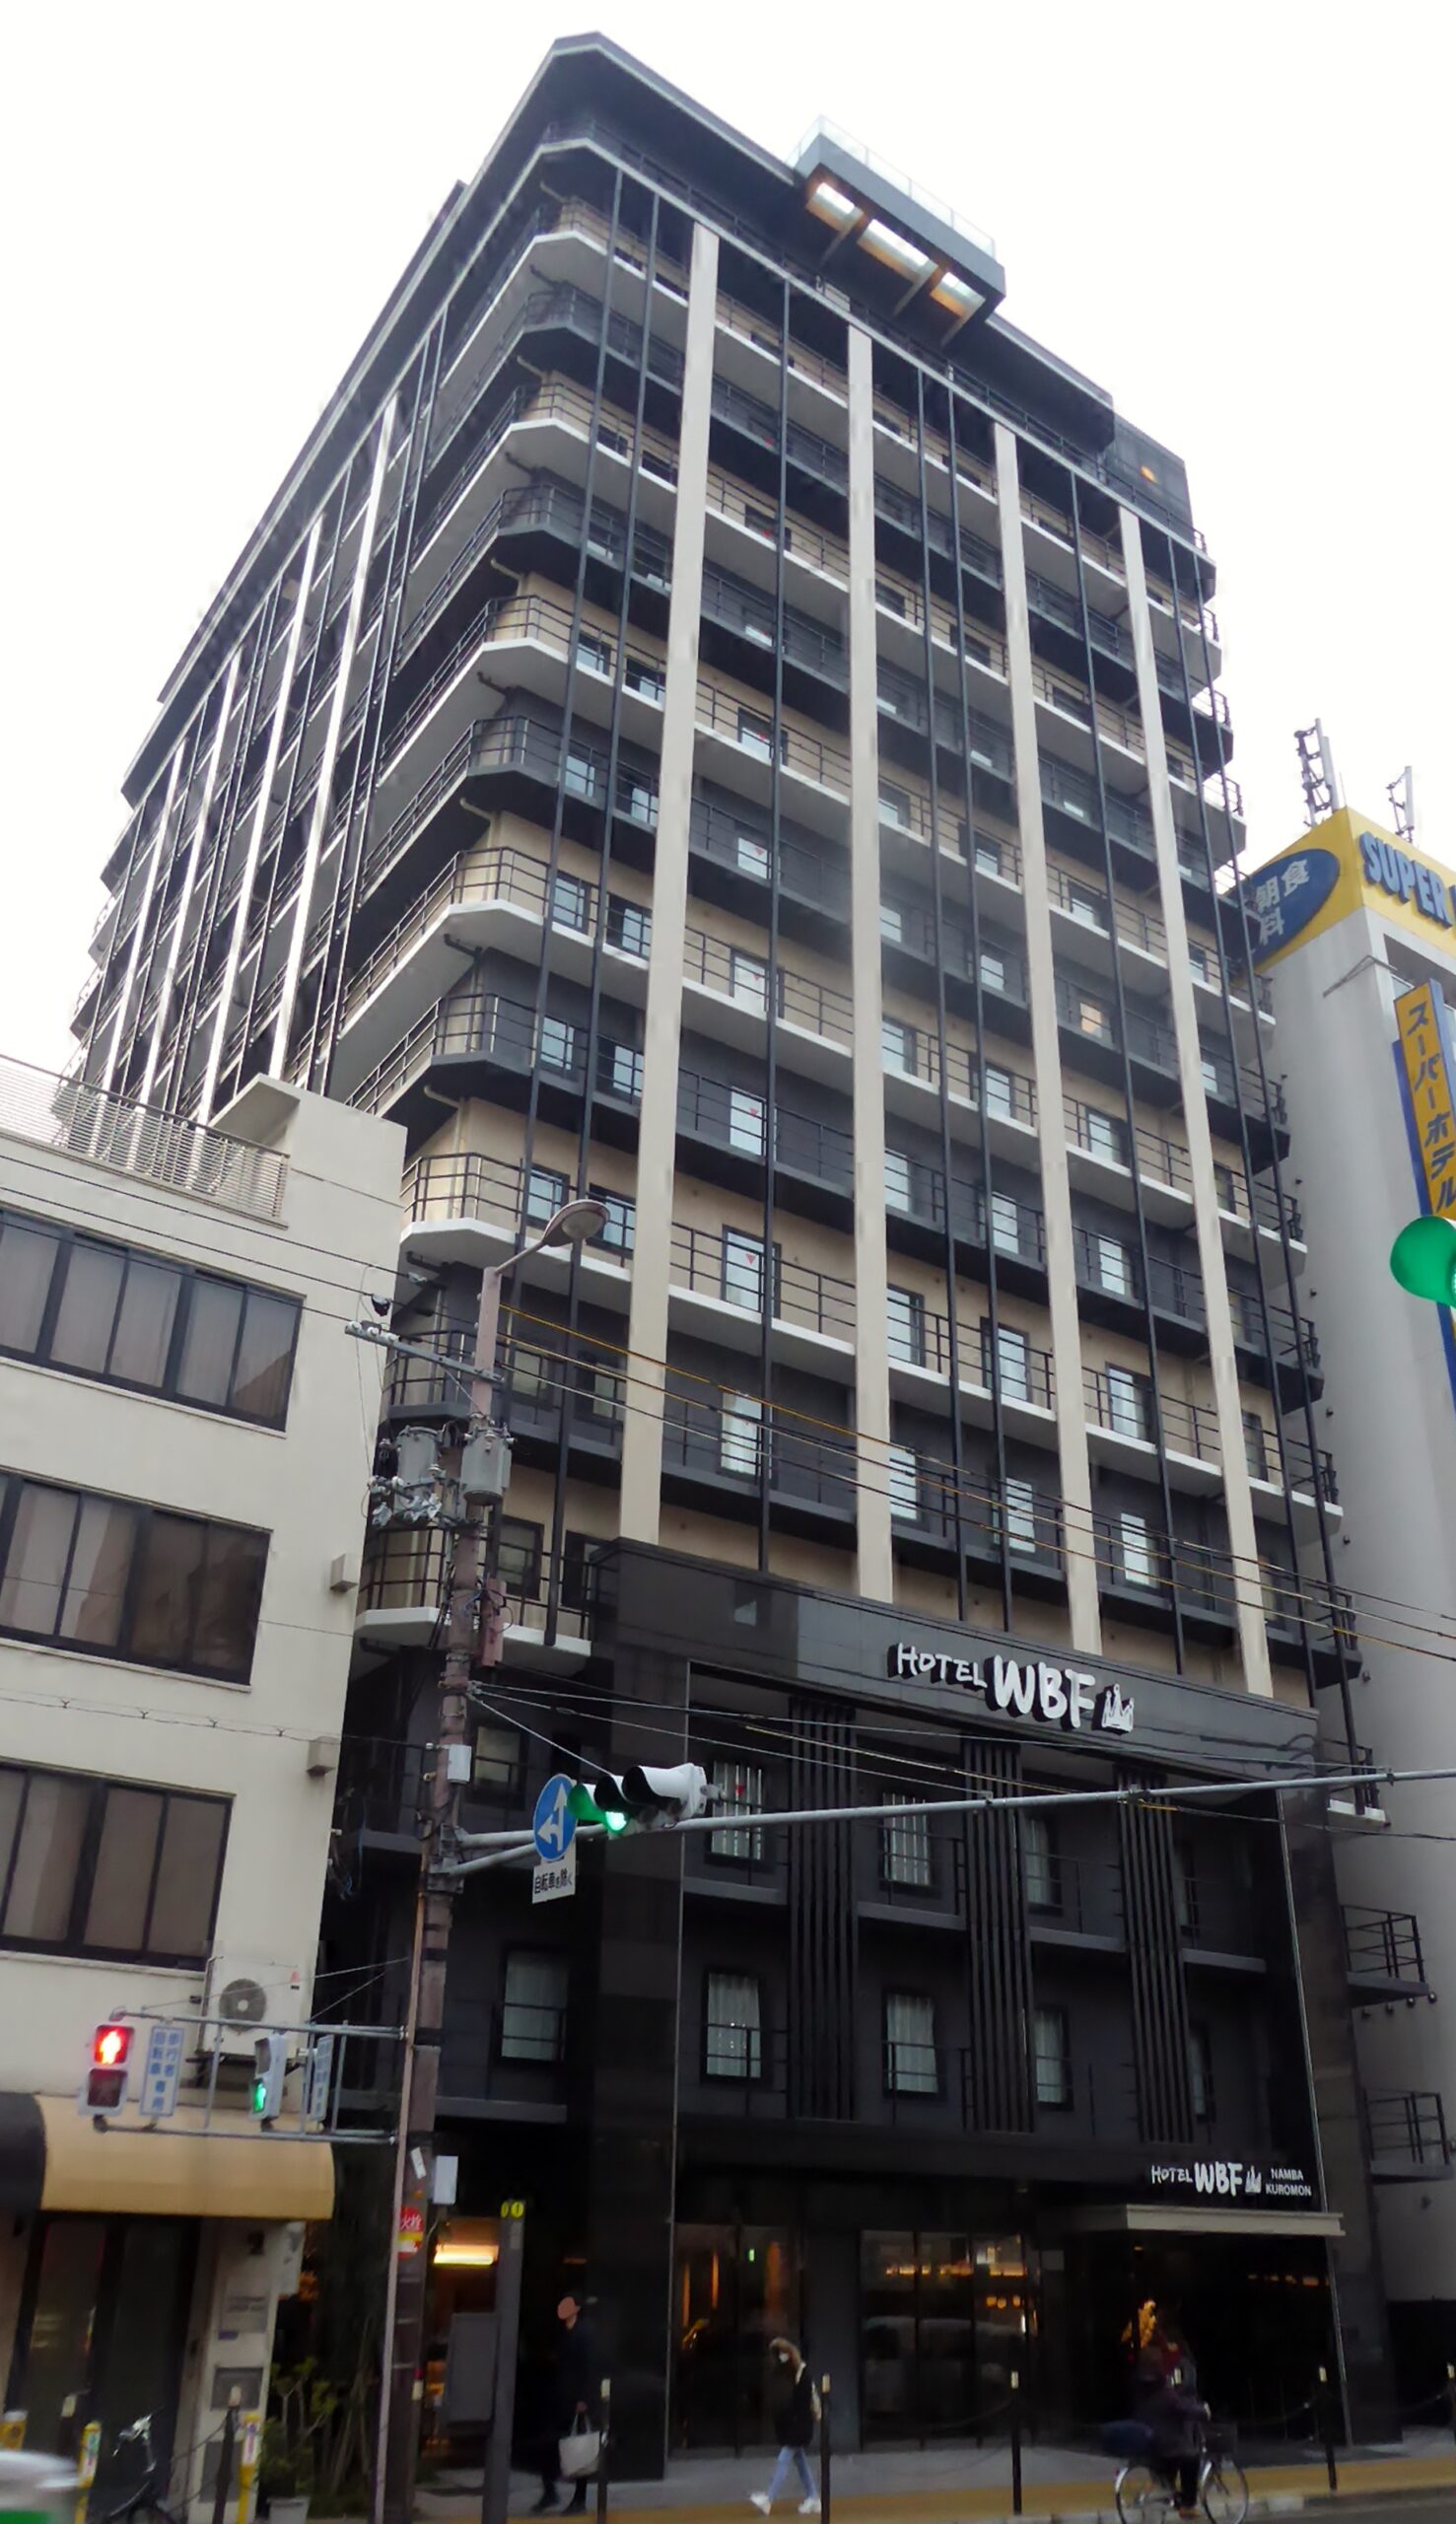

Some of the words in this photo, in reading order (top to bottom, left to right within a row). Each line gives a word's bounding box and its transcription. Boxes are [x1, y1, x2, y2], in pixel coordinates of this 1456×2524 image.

[1255, 859, 1310, 914] 朝食
[1359, 831, 1452, 929] SUPER
[1406, 1000, 1456, 1214] スーパーホテル
[896, 1642, 989, 1688] HOTEL
[991, 1654, 1096, 1728] WBF
[534, 1866, 573, 1894] 自転車を除く
[1150, 2164, 1193, 2184] HOTEL
[1194, 2161, 1244, 2197] WBF
[1265, 2182, 1312, 2197] KUROMON
[1270, 2167, 1304, 2182] NAMBA
